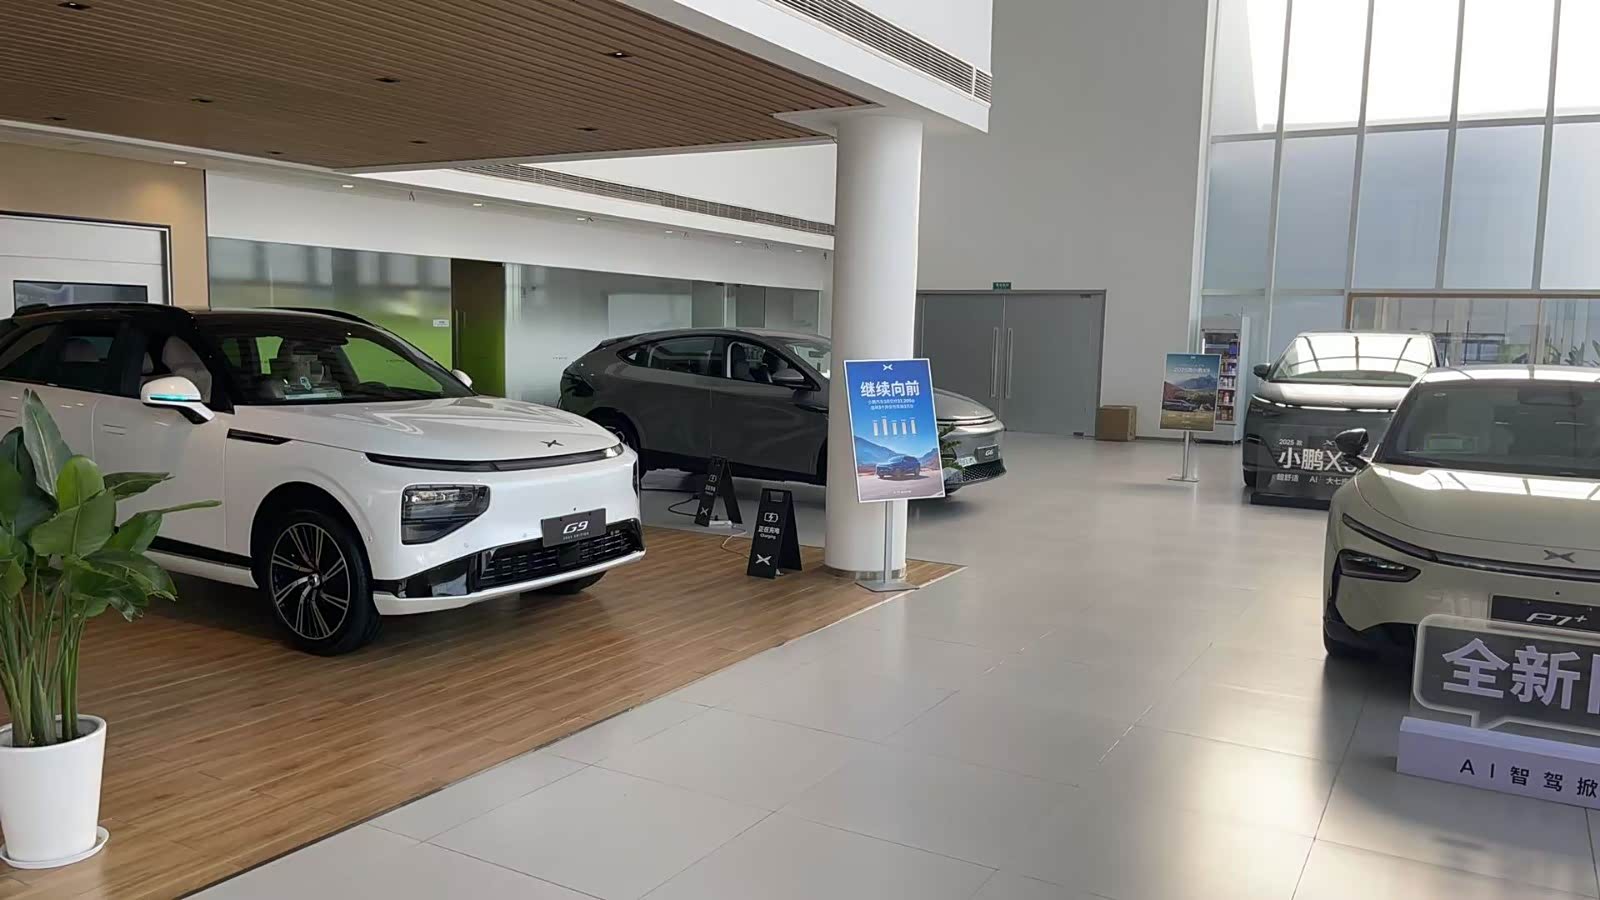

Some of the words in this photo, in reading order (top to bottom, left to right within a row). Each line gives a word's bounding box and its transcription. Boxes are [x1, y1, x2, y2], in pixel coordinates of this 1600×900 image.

[860, 380, 920, 398] 继续向前
[1279, 438, 1295, 446] 2025
[1309, 475, 1318, 483] AI
[563, 520, 589, 534] G9
[758, 525, 780, 535] 正在充电
[1526, 612, 1588, 626] P7+
